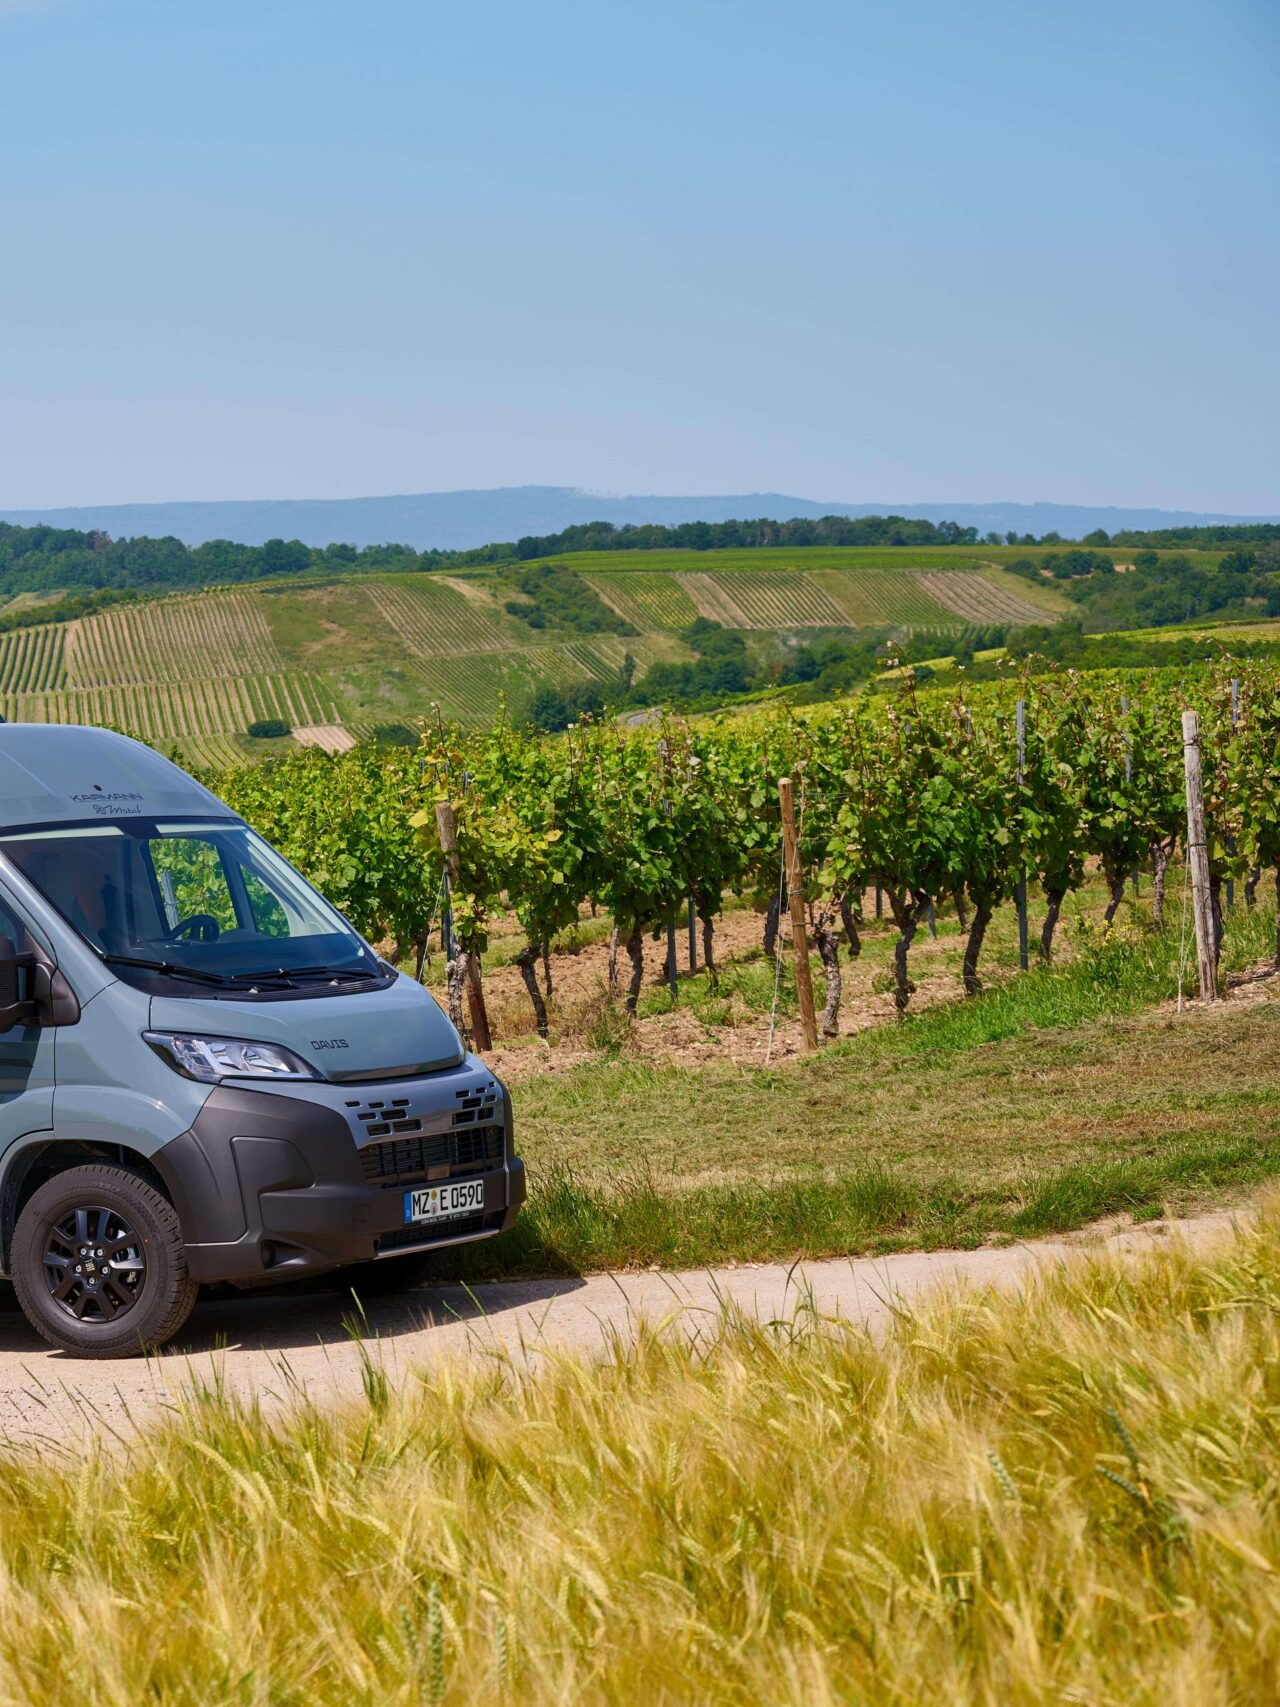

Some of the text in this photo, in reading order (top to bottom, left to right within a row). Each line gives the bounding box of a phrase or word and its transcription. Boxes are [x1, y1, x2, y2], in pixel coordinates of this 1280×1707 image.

[69, 793, 144, 801] KARMANN
[311, 1039, 349, 1050] DAVIS
[412, 1183, 483, 1216] MZ E 0590
